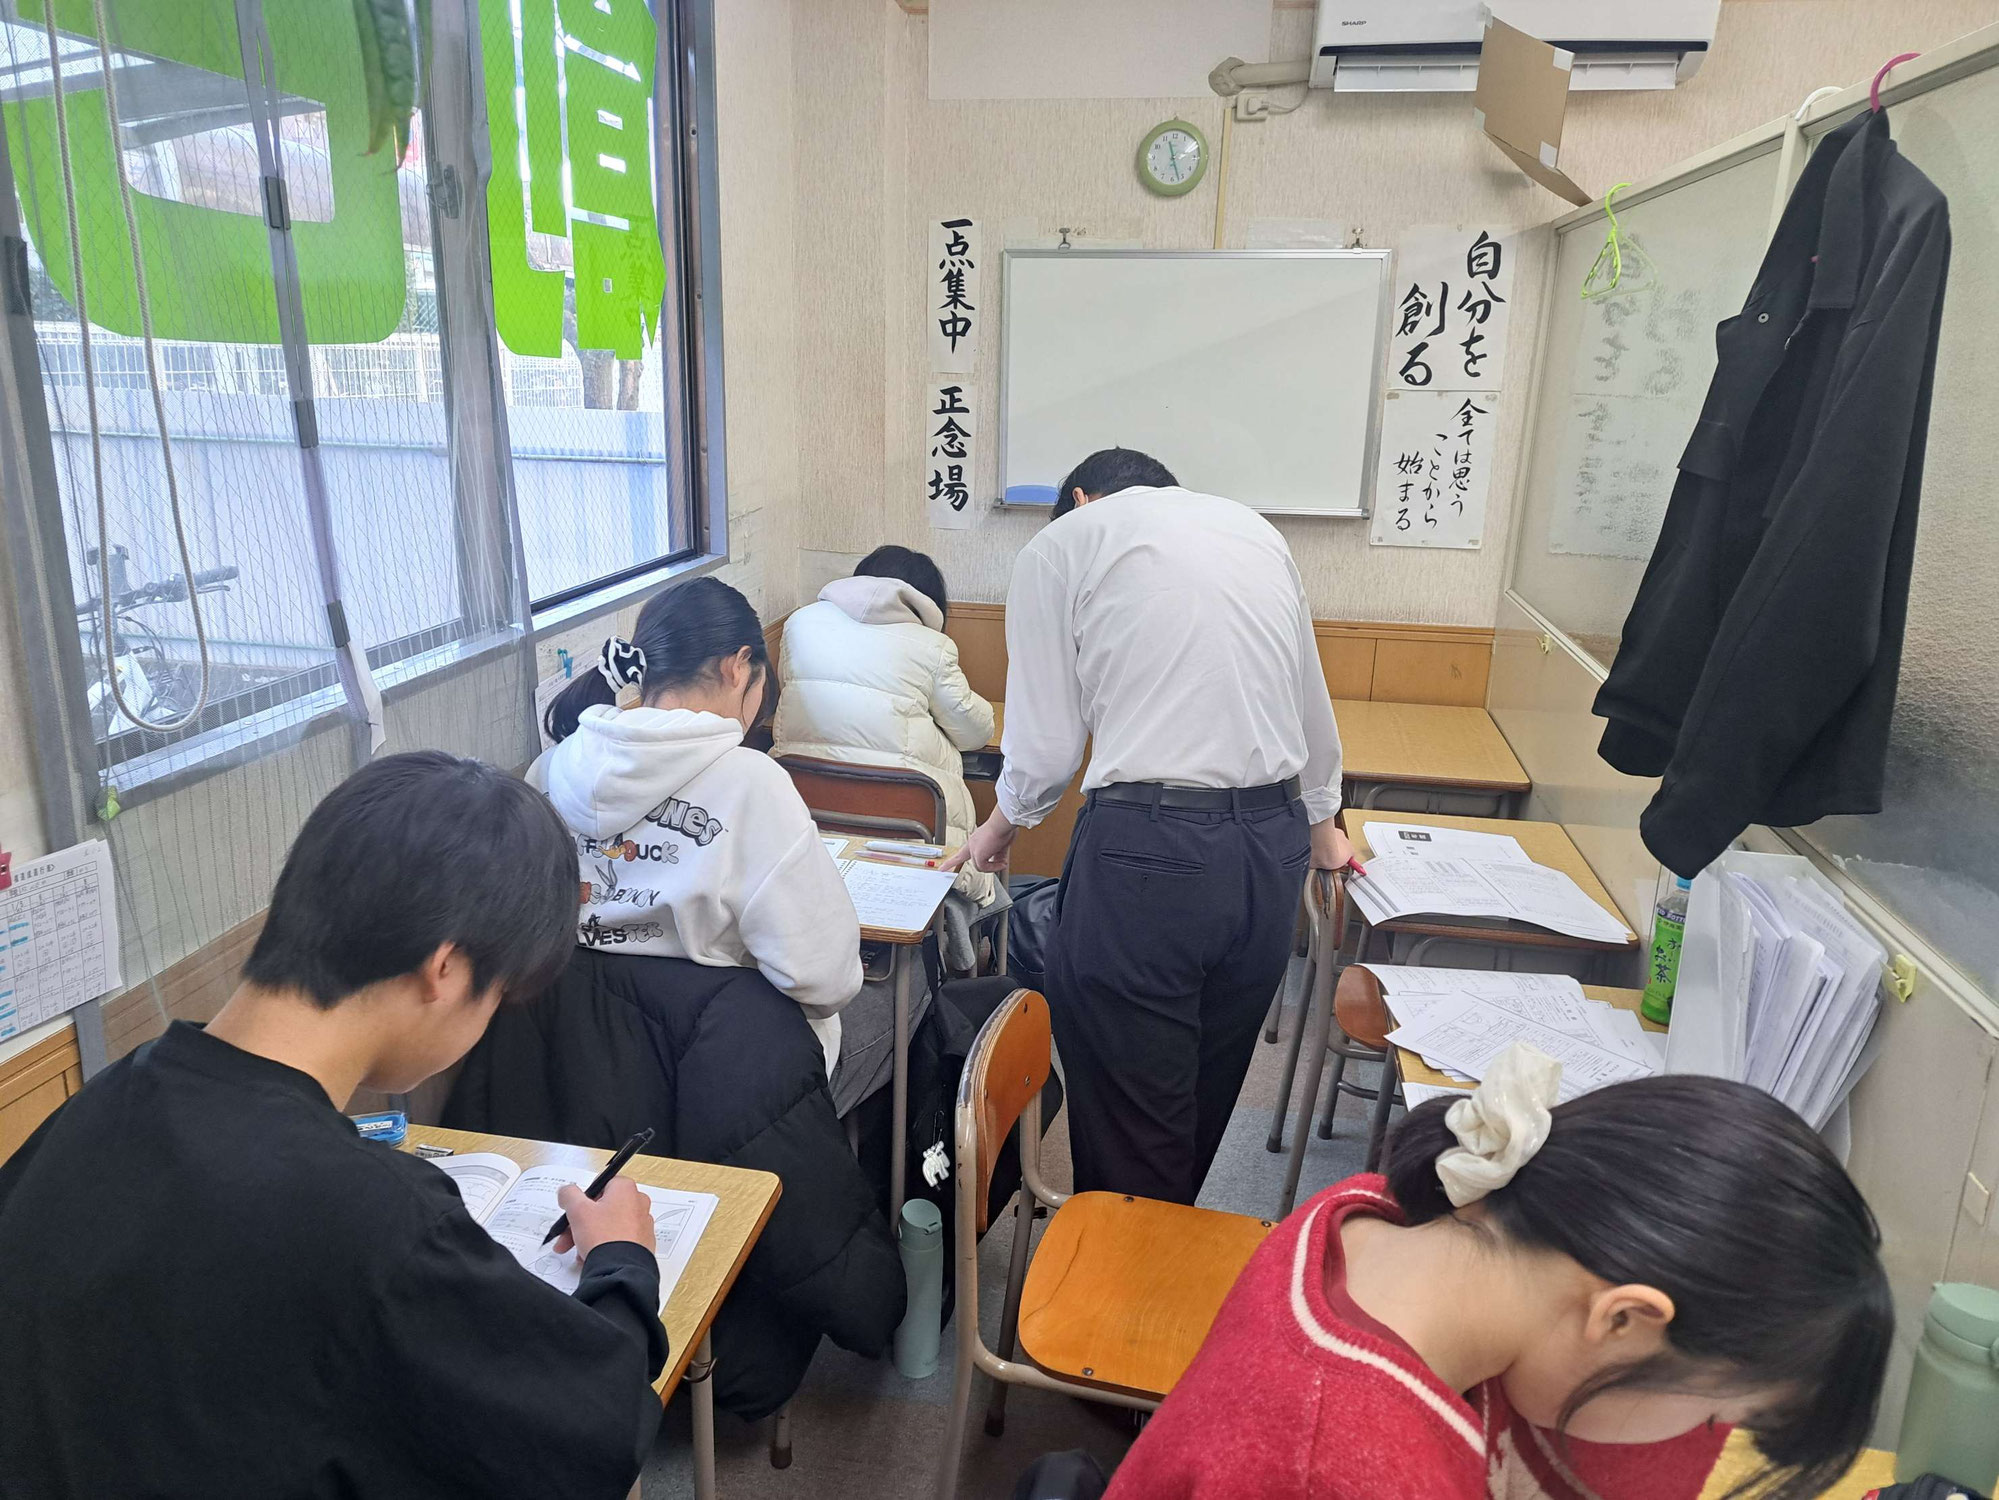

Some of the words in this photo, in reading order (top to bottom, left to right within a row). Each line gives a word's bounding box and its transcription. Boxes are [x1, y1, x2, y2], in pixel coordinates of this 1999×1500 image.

[938, 218, 976, 354] 一点集中
[1395, 281, 1449, 387] 創る
[1457, 230, 1506, 379] 自分を
[927, 386, 973, 512] 正念場
[1393, 451, 1424, 532] 始まる
[1423, 432, 1448, 529] ことから
[1450, 397, 1488, 516] 全ては思う
